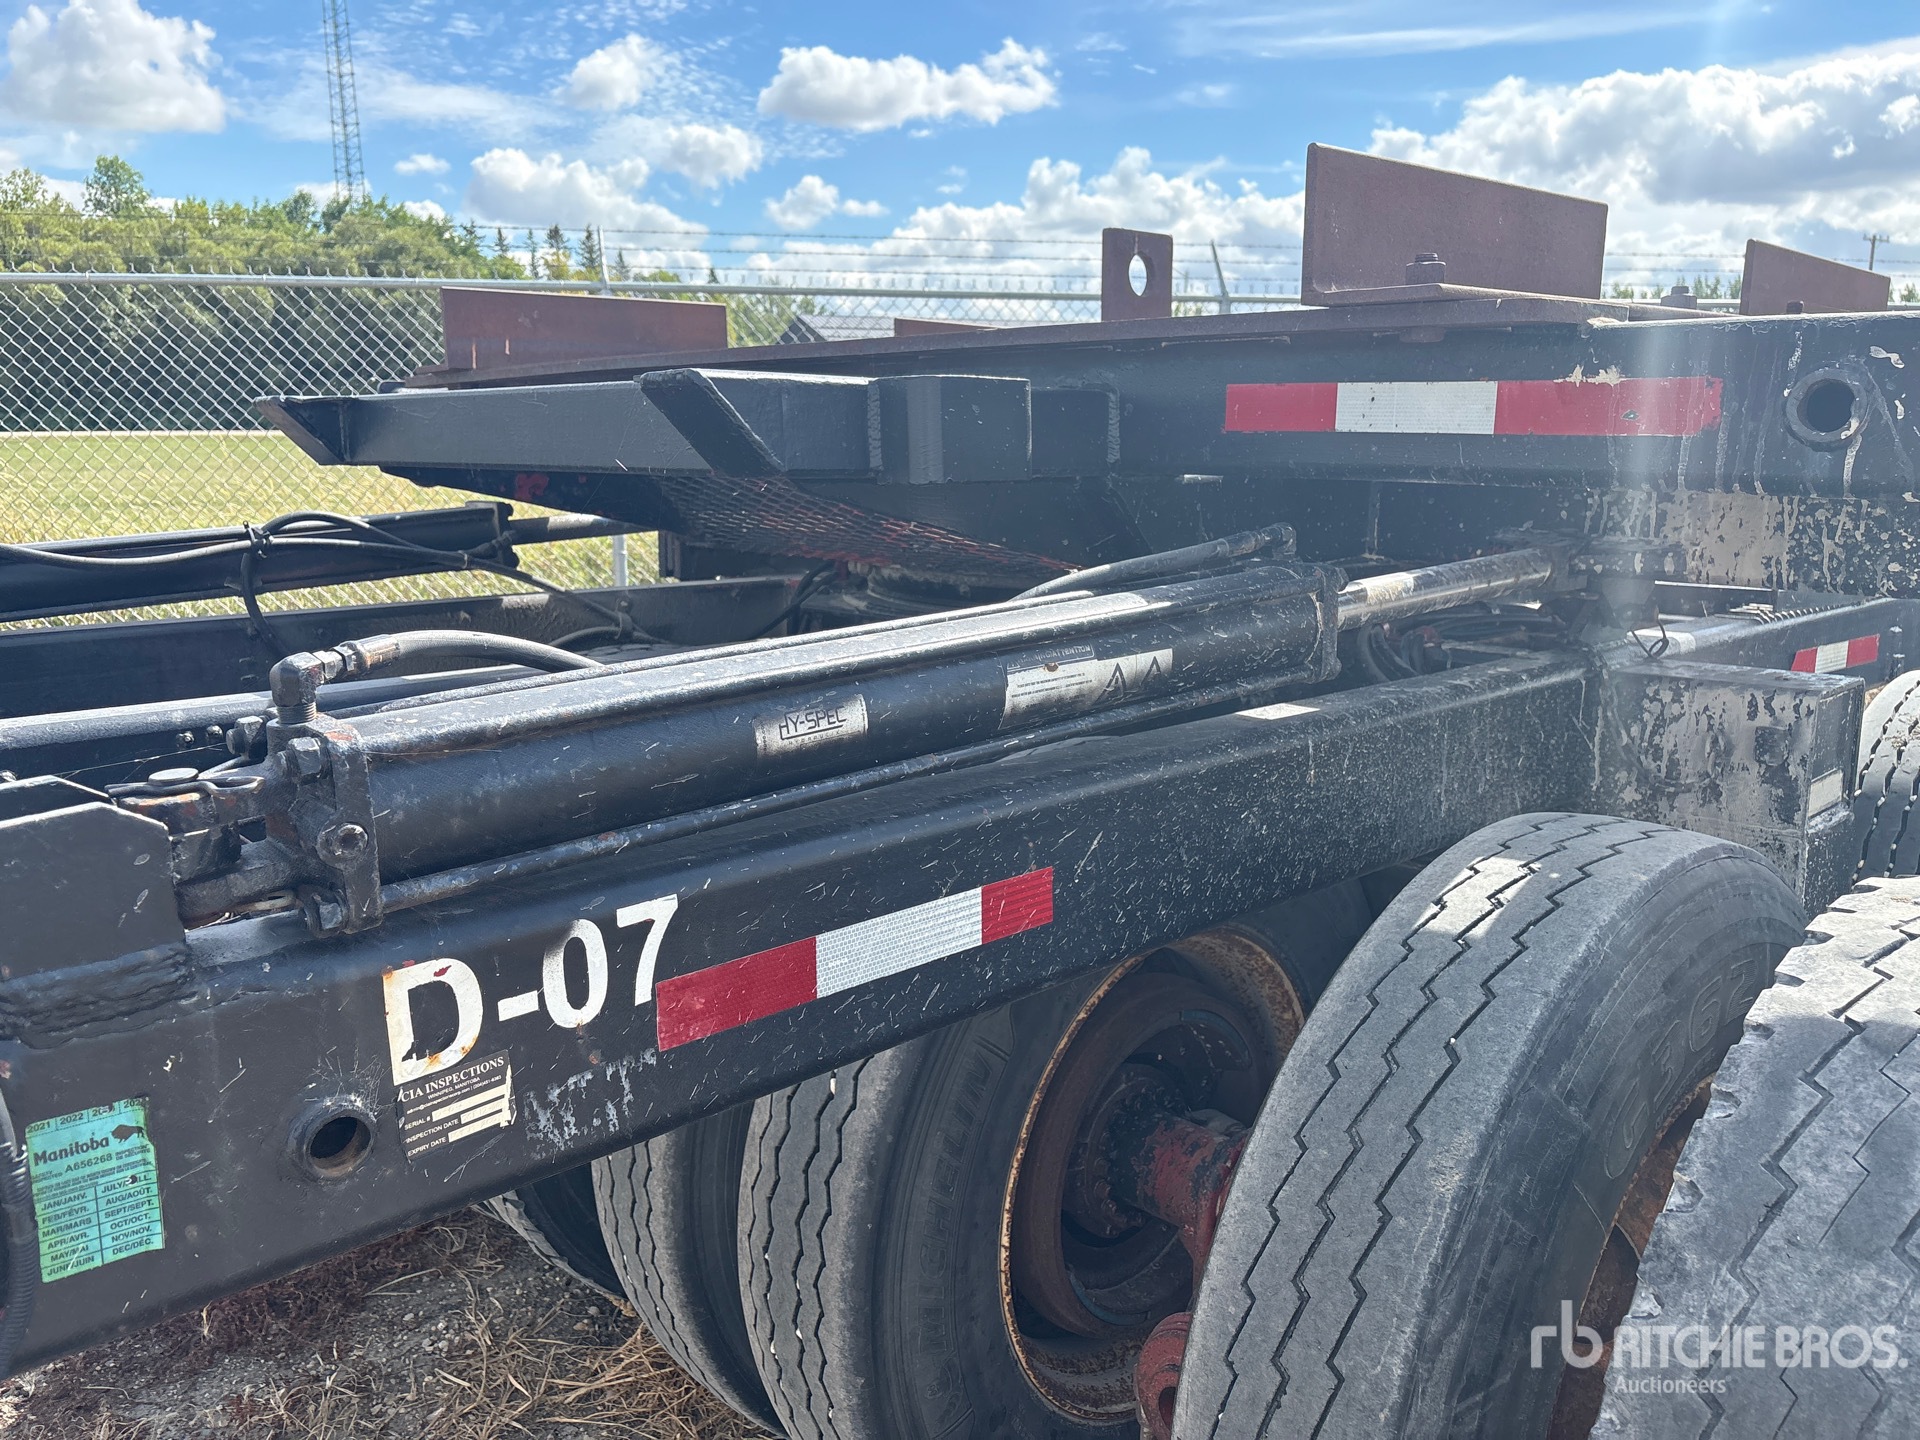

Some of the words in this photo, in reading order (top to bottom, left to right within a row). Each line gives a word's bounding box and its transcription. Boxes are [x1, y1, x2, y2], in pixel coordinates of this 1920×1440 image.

[779, 706, 847, 740] HY-SPEC
[382, 894, 679, 1086] D-07
[401, 1087, 424, 1102] CIA
[425, 1056, 505, 1094] INSPECTIONS
[27, 1121, 51, 1134] 2021
[60, 1112, 84, 1125] 2022
[404, 1117, 426, 1131] SERIAL
[405, 1124, 443, 1144] INSPECTION
[443, 1118, 460, 1130] DATE
[33, 1136, 110, 1167] Manitoba
[407, 1142, 430, 1157] EXPIRY
[430, 1136, 448, 1148] DATE
[65, 1153, 113, 1173] A656268
[104, 1199, 155, 1219] SEPT/SEPT.
[918, 1050, 993, 1354] MICHELIN
[42, 1217, 92, 1238] MAR/MARS
[110, 1212, 151, 1230] OCT/OCT.
[111, 1225, 153, 1243] NOV/NOV.
